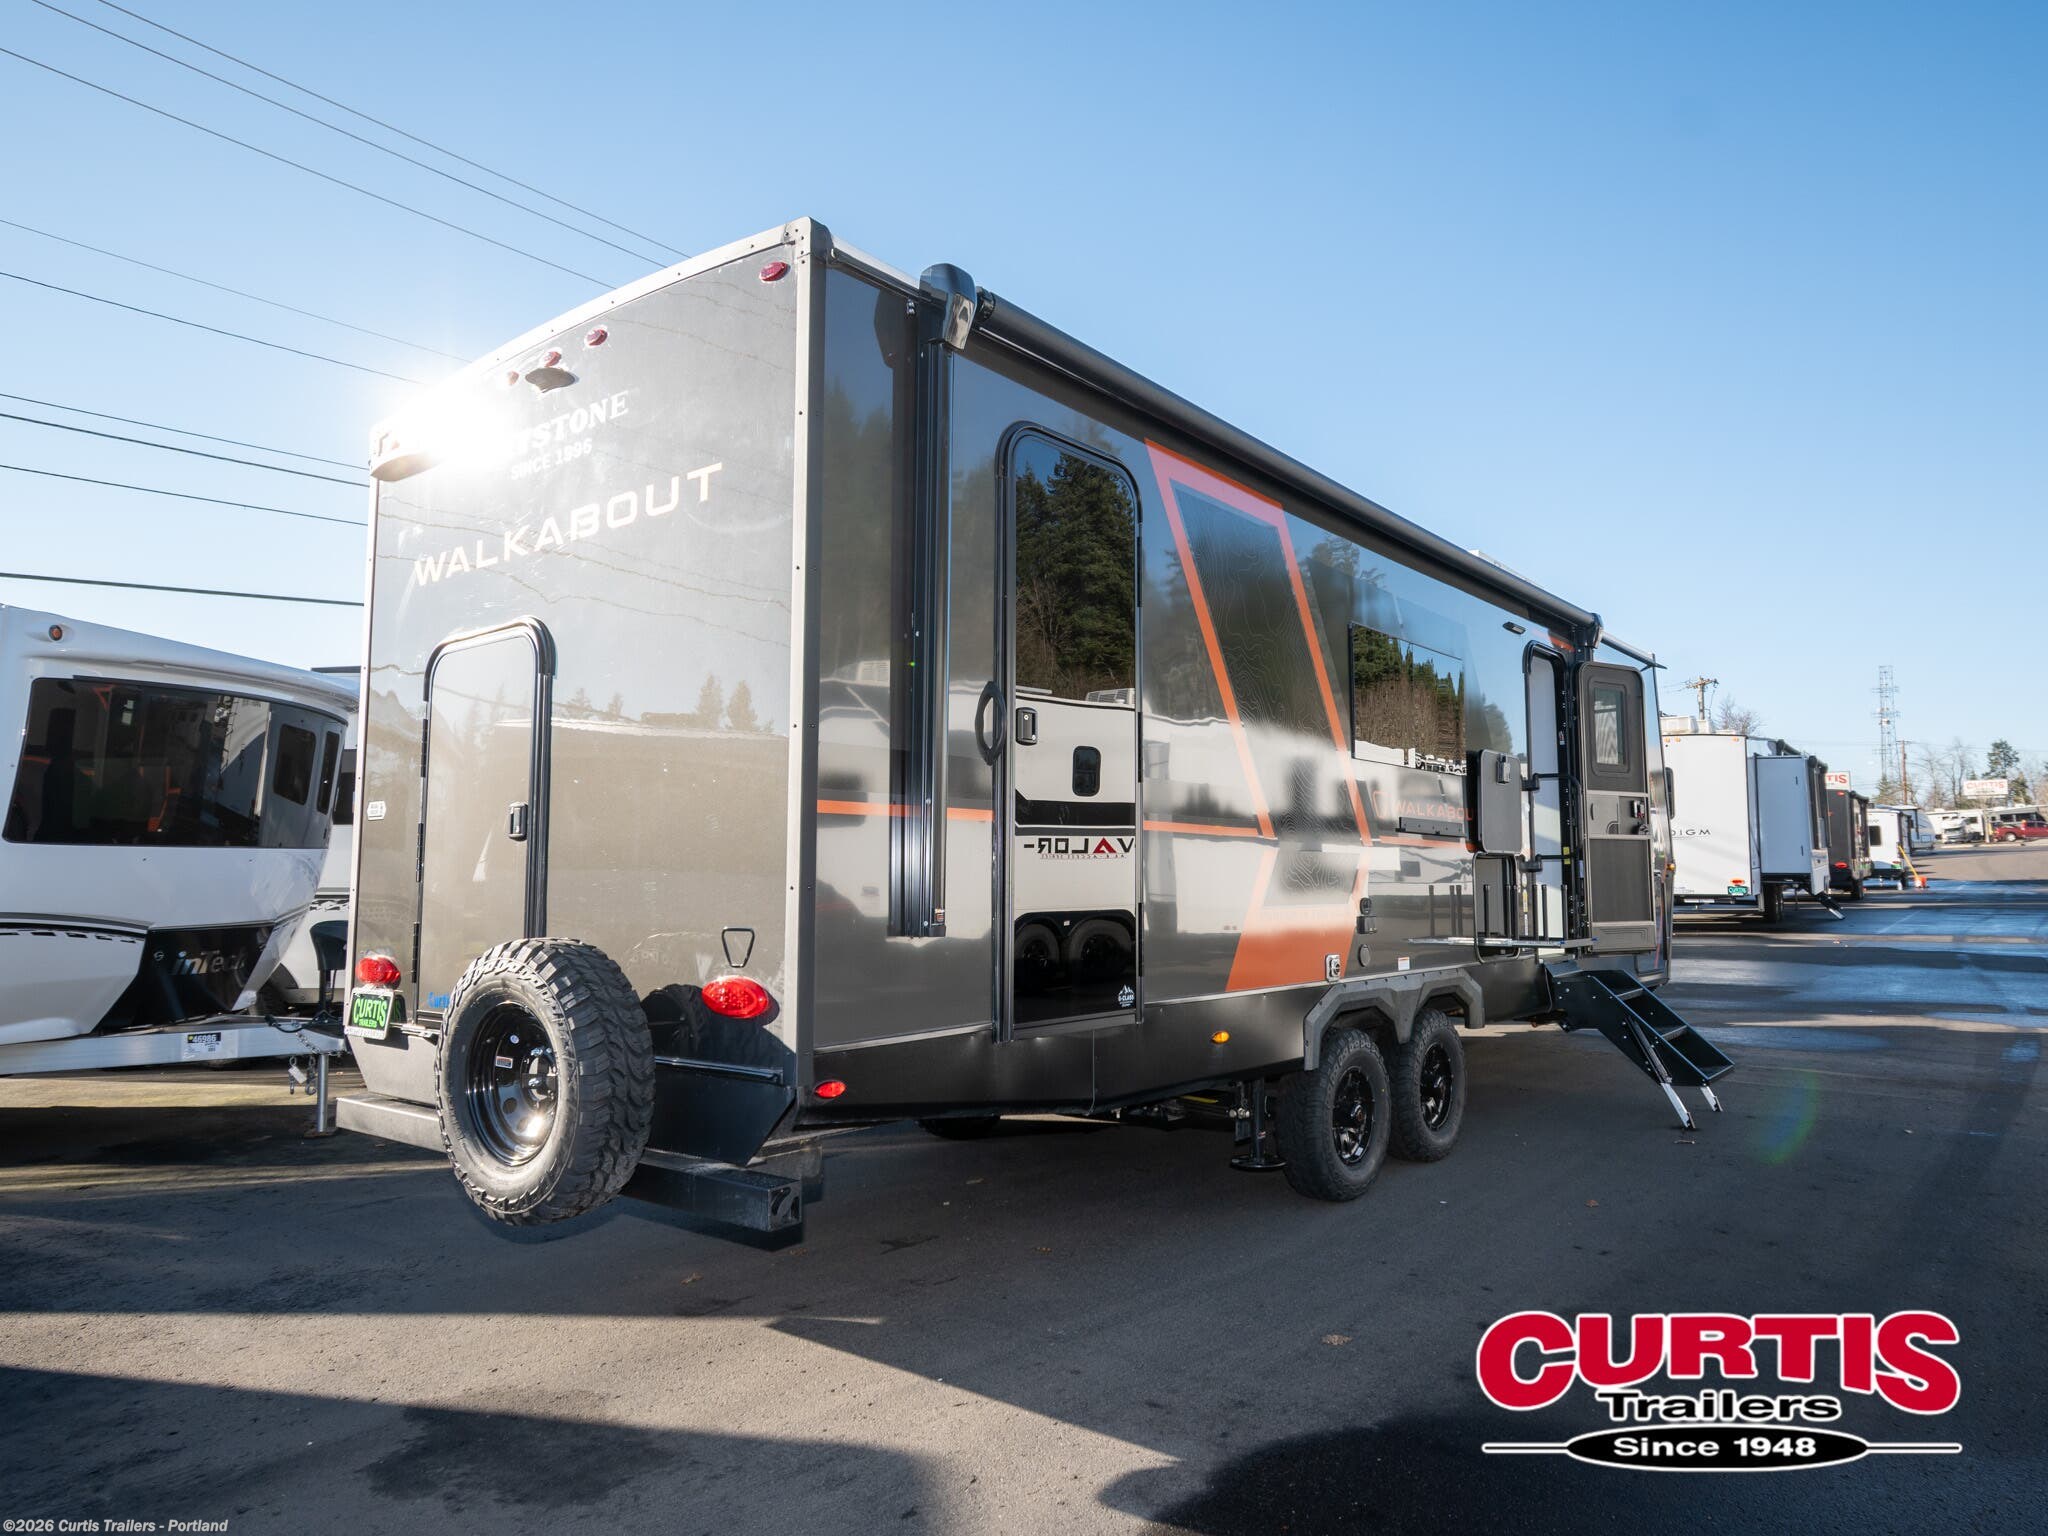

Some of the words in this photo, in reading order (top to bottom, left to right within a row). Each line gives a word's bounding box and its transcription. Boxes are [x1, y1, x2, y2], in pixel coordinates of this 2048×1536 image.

[413, 462, 723, 586] WALKABOUT
[1826, 774, 1848, 784] TIS
[353, 997, 388, 1028] CURTIS
